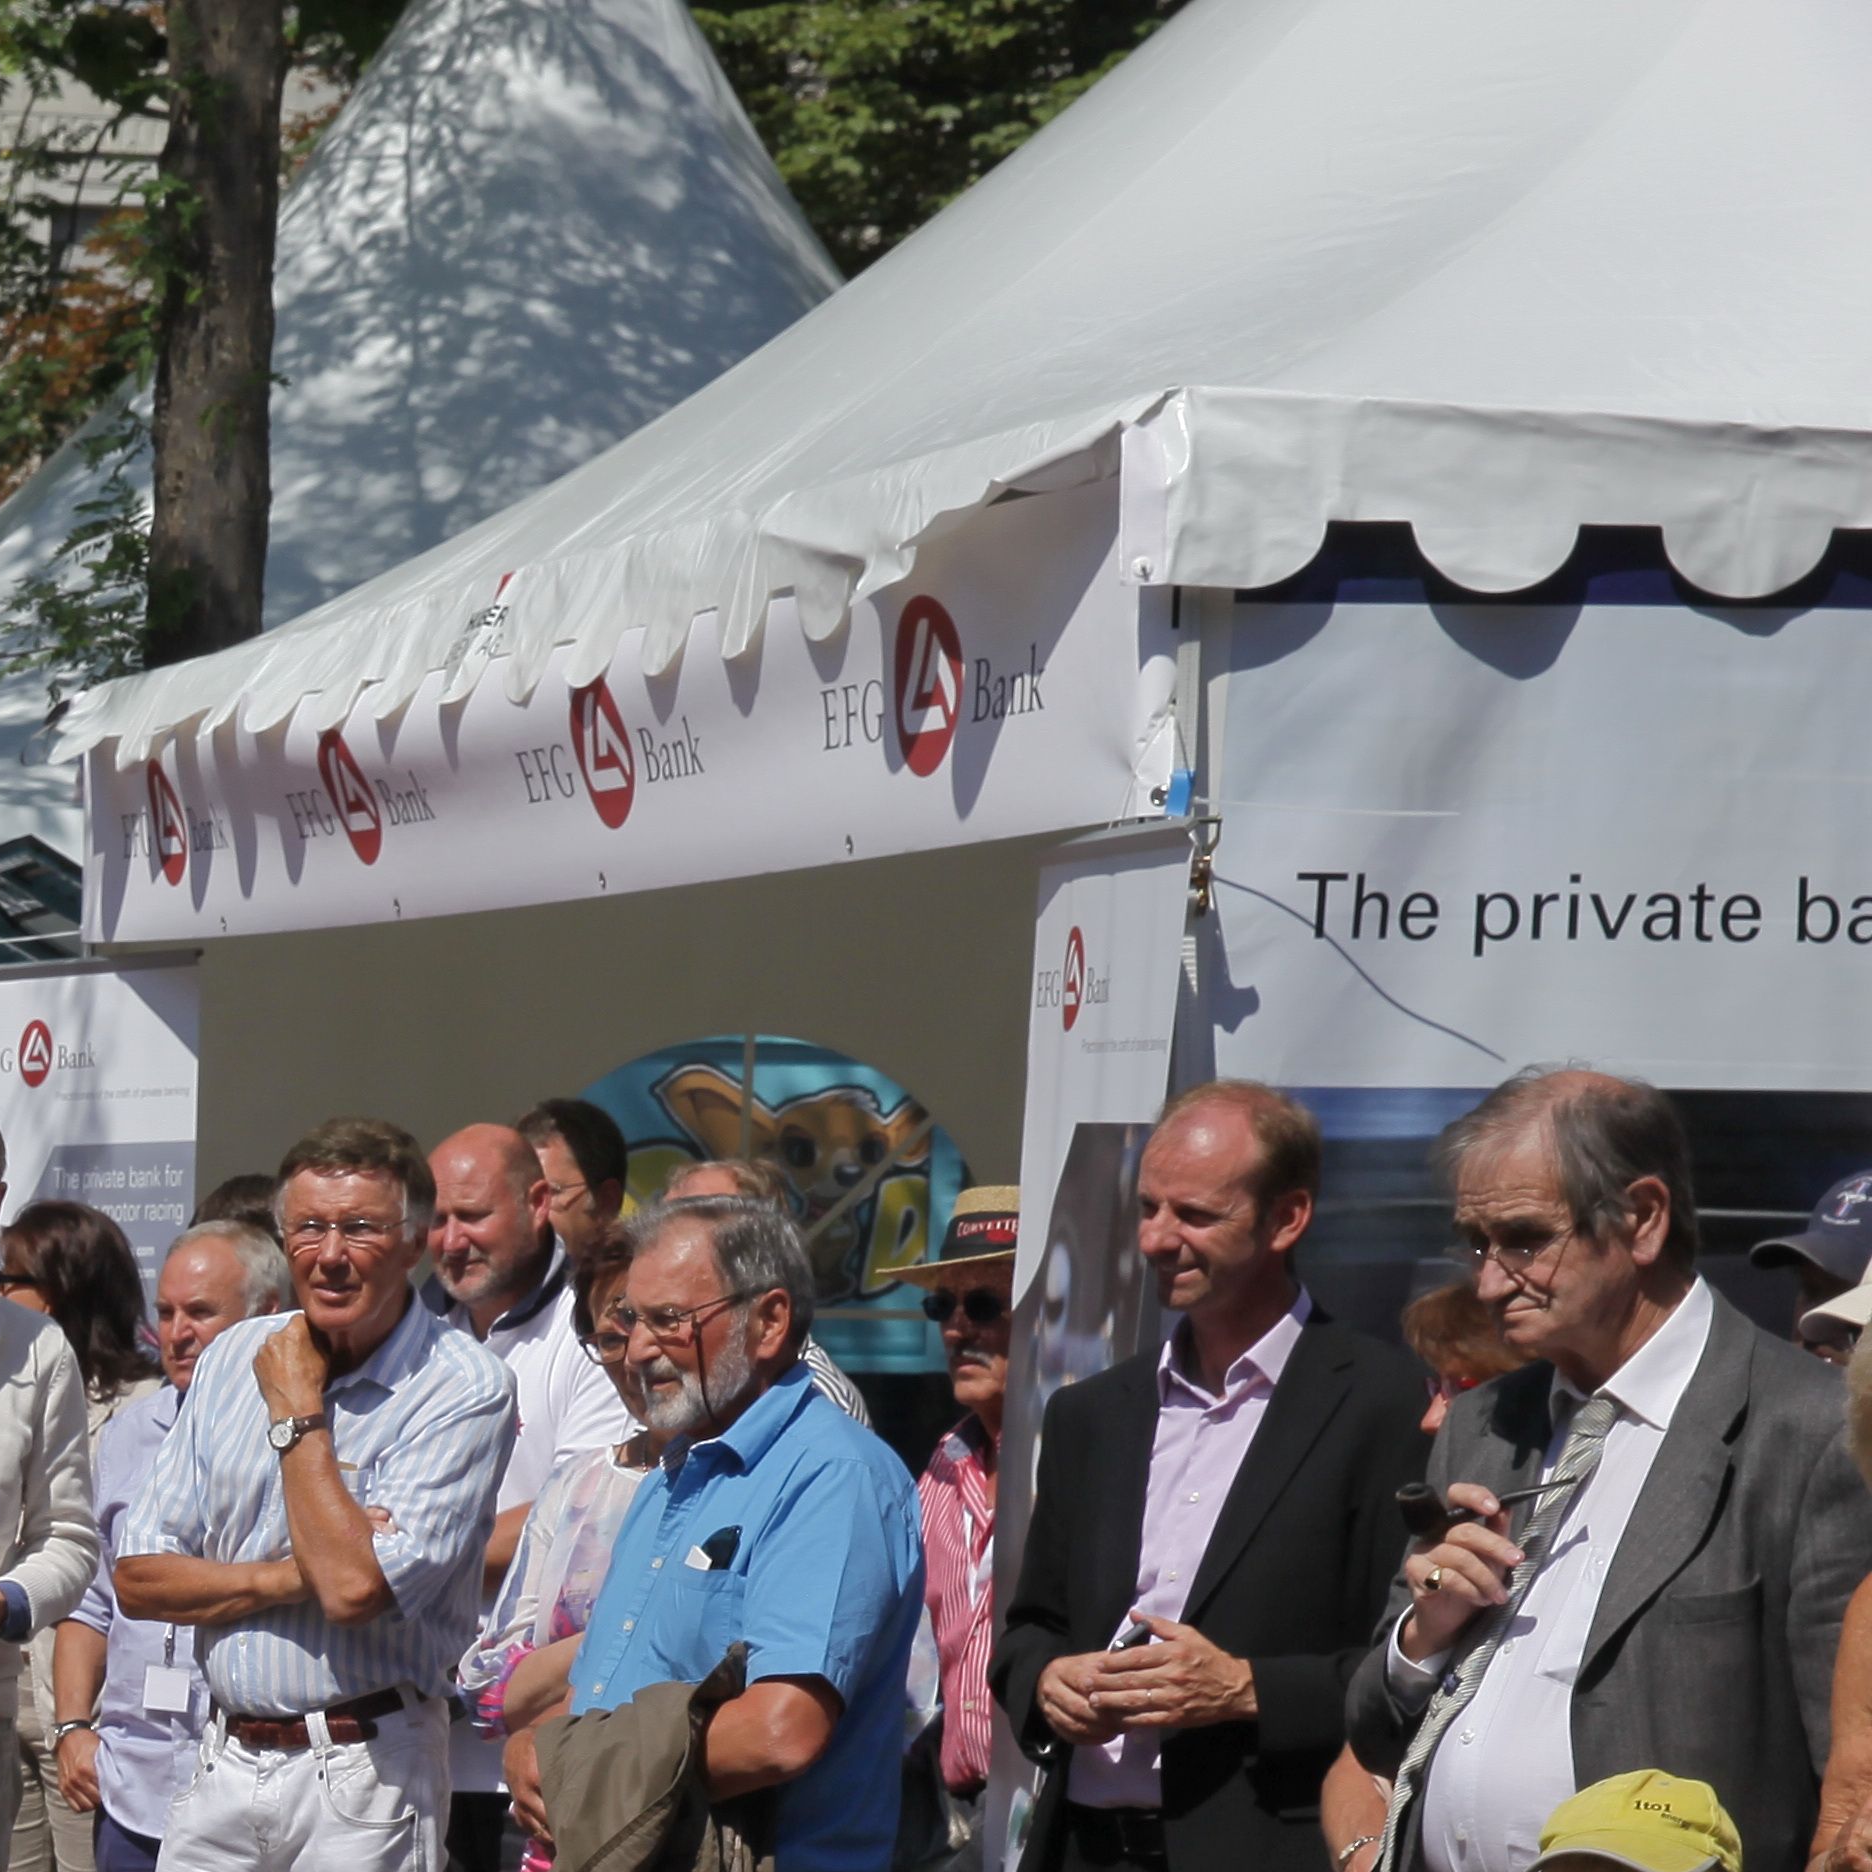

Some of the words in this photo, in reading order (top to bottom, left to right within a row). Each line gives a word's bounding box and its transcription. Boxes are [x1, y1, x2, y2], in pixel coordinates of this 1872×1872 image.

[820, 680, 886, 751] EFG
[971, 643, 1046, 724] Bank
[515, 743, 575, 803] EFG
[637, 716, 706, 785] Bank
[286, 789, 337, 840] EFG
[375, 770, 436, 828] Bank
[1297, 872, 1440, 940] The
[1472, 873, 1763, 958] private
[1795, 876, 1872, 945] ba
[1036, 968, 1061, 1008] EFG
[56, 1043, 97, 1070] Bank
[53, 1166, 80, 1190] The
[82, 1165, 125, 1196] private
[128, 1165, 161, 1189] bank
[164, 1163, 184, 1188] for
[100, 1203, 141, 1223] motor
[144, 1198, 185, 1226] racing
[1634, 1799, 1672, 1813] 1to1
